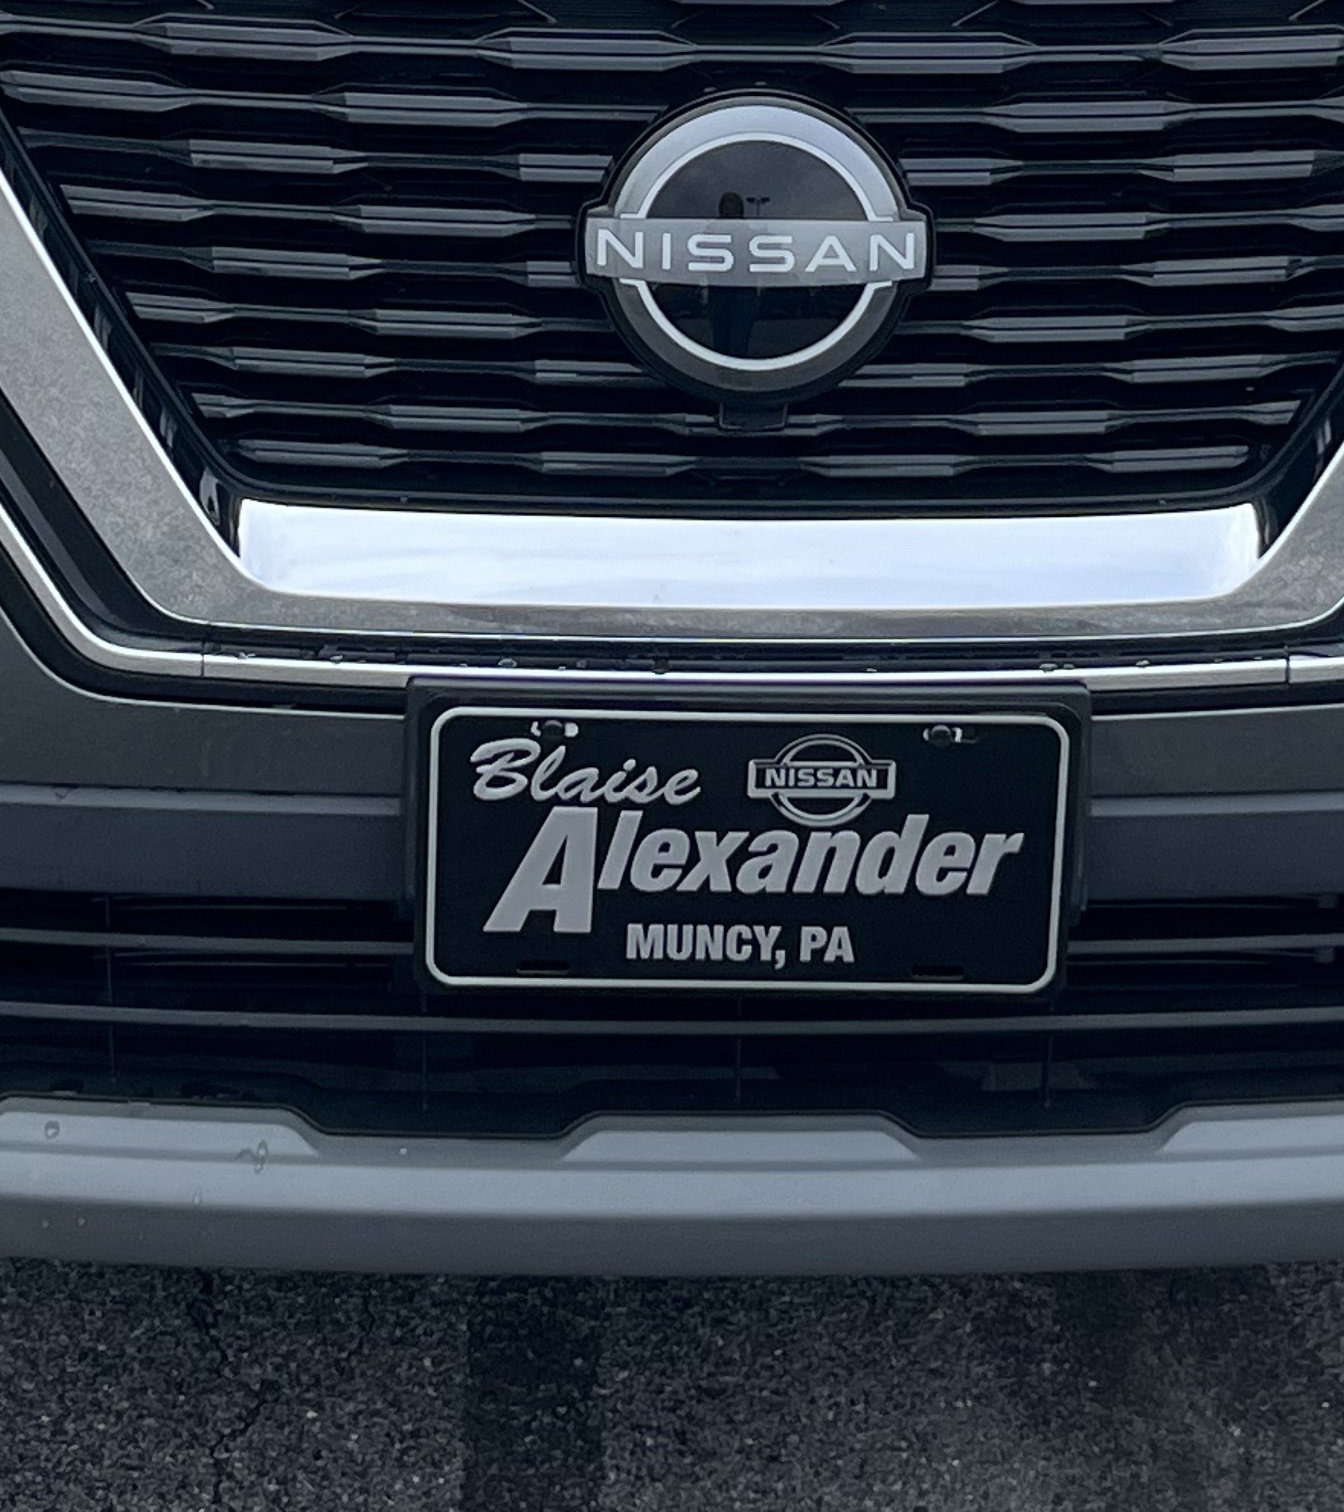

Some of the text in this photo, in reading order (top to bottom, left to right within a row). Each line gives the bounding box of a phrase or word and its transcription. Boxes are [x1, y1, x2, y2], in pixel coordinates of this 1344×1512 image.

[597, 228, 915, 273] NISSAN
[470, 738, 701, 805] Blaise
[764, 765, 878, 789] NISSAN
[483, 805, 1025, 934] Alexander
[625, 923, 854, 970] MUNCY, PA
